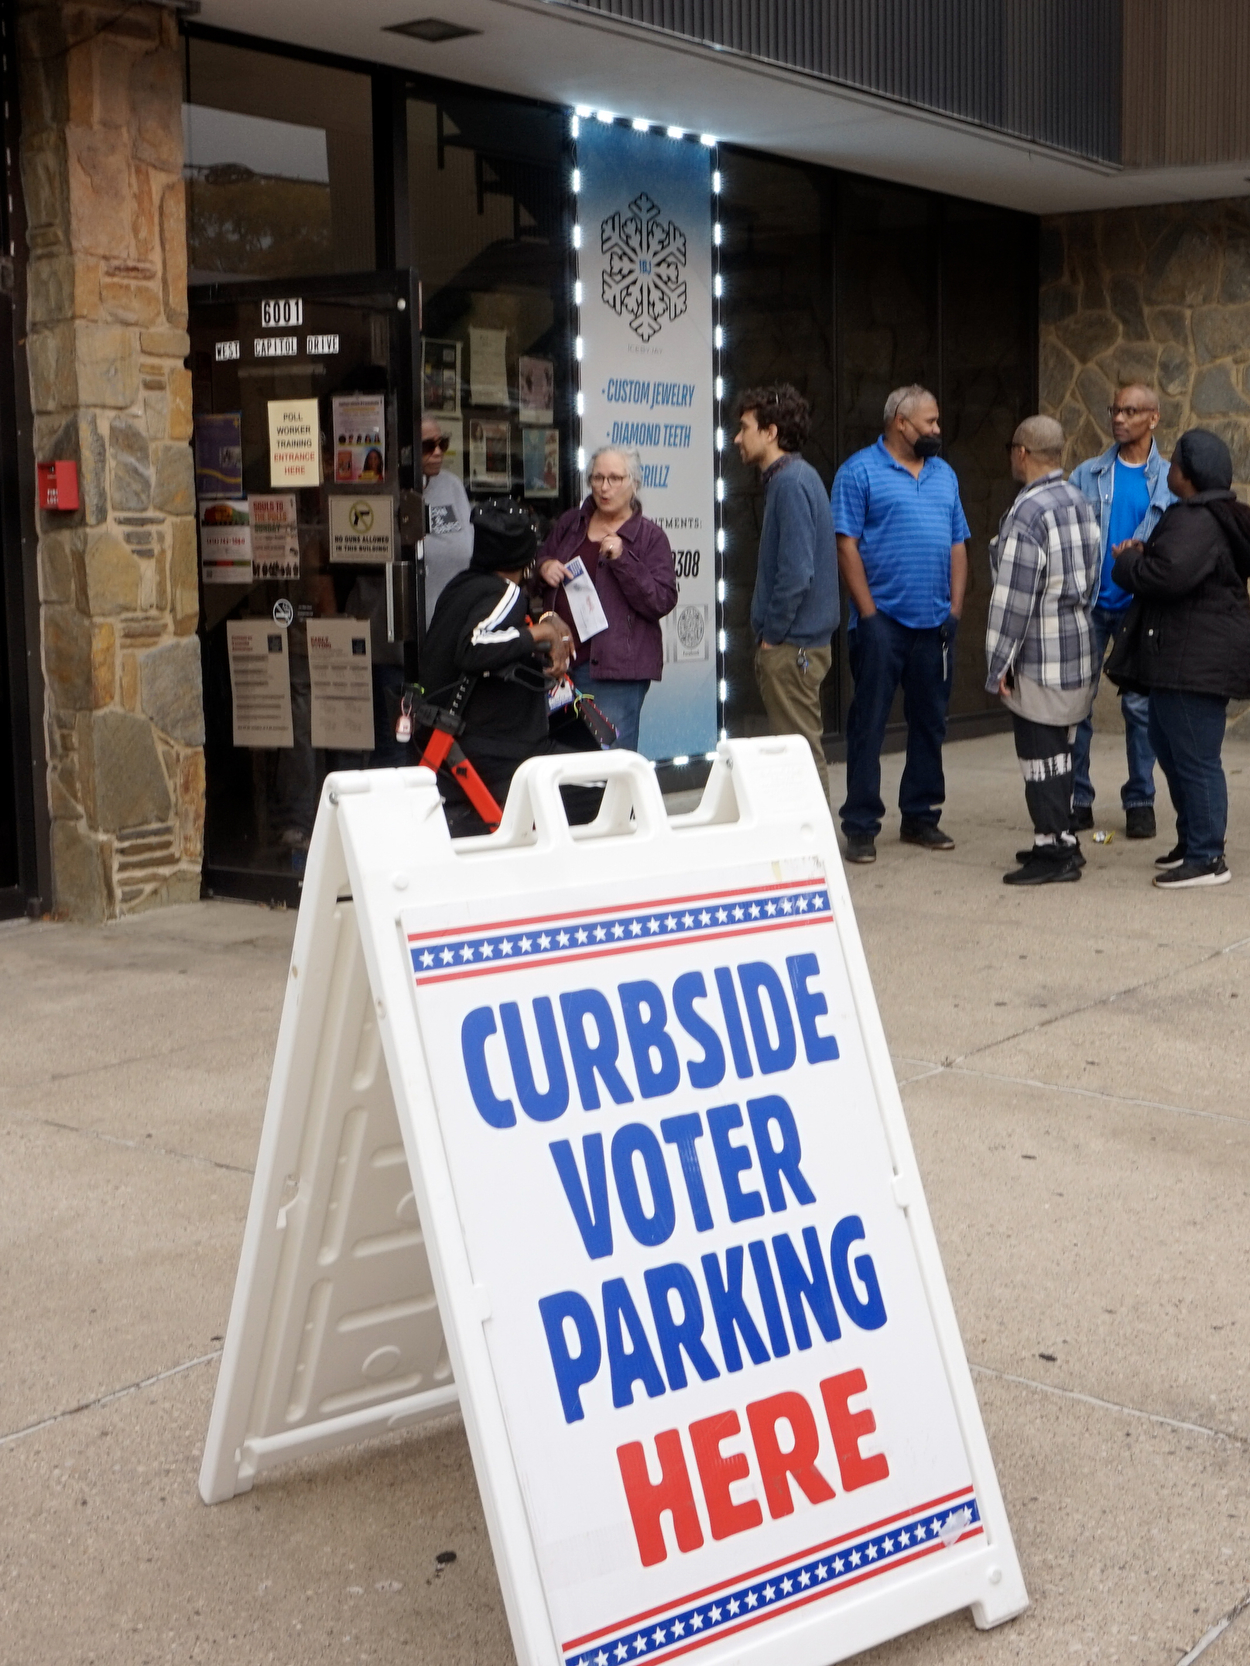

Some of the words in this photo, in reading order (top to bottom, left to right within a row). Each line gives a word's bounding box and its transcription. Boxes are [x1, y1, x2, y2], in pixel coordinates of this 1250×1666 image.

[263, 299, 301, 325] 6001
[216, 341, 239, 360] WEST
[254, 337, 297, 356] CAPITOL
[307, 335, 338, 354] DRIVE
[607, 377, 650, 405] CUSTOM
[650, 381, 695, 409] JEWELRY
[283, 412, 303, 422] POLL
[277, 425, 311, 436] WORKER
[611, 421, 661, 446] DIAMOND
[663, 423, 692, 448] TEETH
[276, 438, 312, 449] TRAINING
[274, 451, 315, 462] ENTRANCE
[284, 465, 305, 475] HERE
[651, 517, 702, 529] NTMENTS:
[334, 535, 343, 543] NO
[345, 535, 360, 543] GUNS
[362, 535, 389, 543] ALLOWED
[461, 952, 840, 1129] CURBSIDE
[548, 1095, 817, 1260] VOTER
[538, 1215, 888, 1424] PARKING
[616, 1368, 890, 1567] HERE
